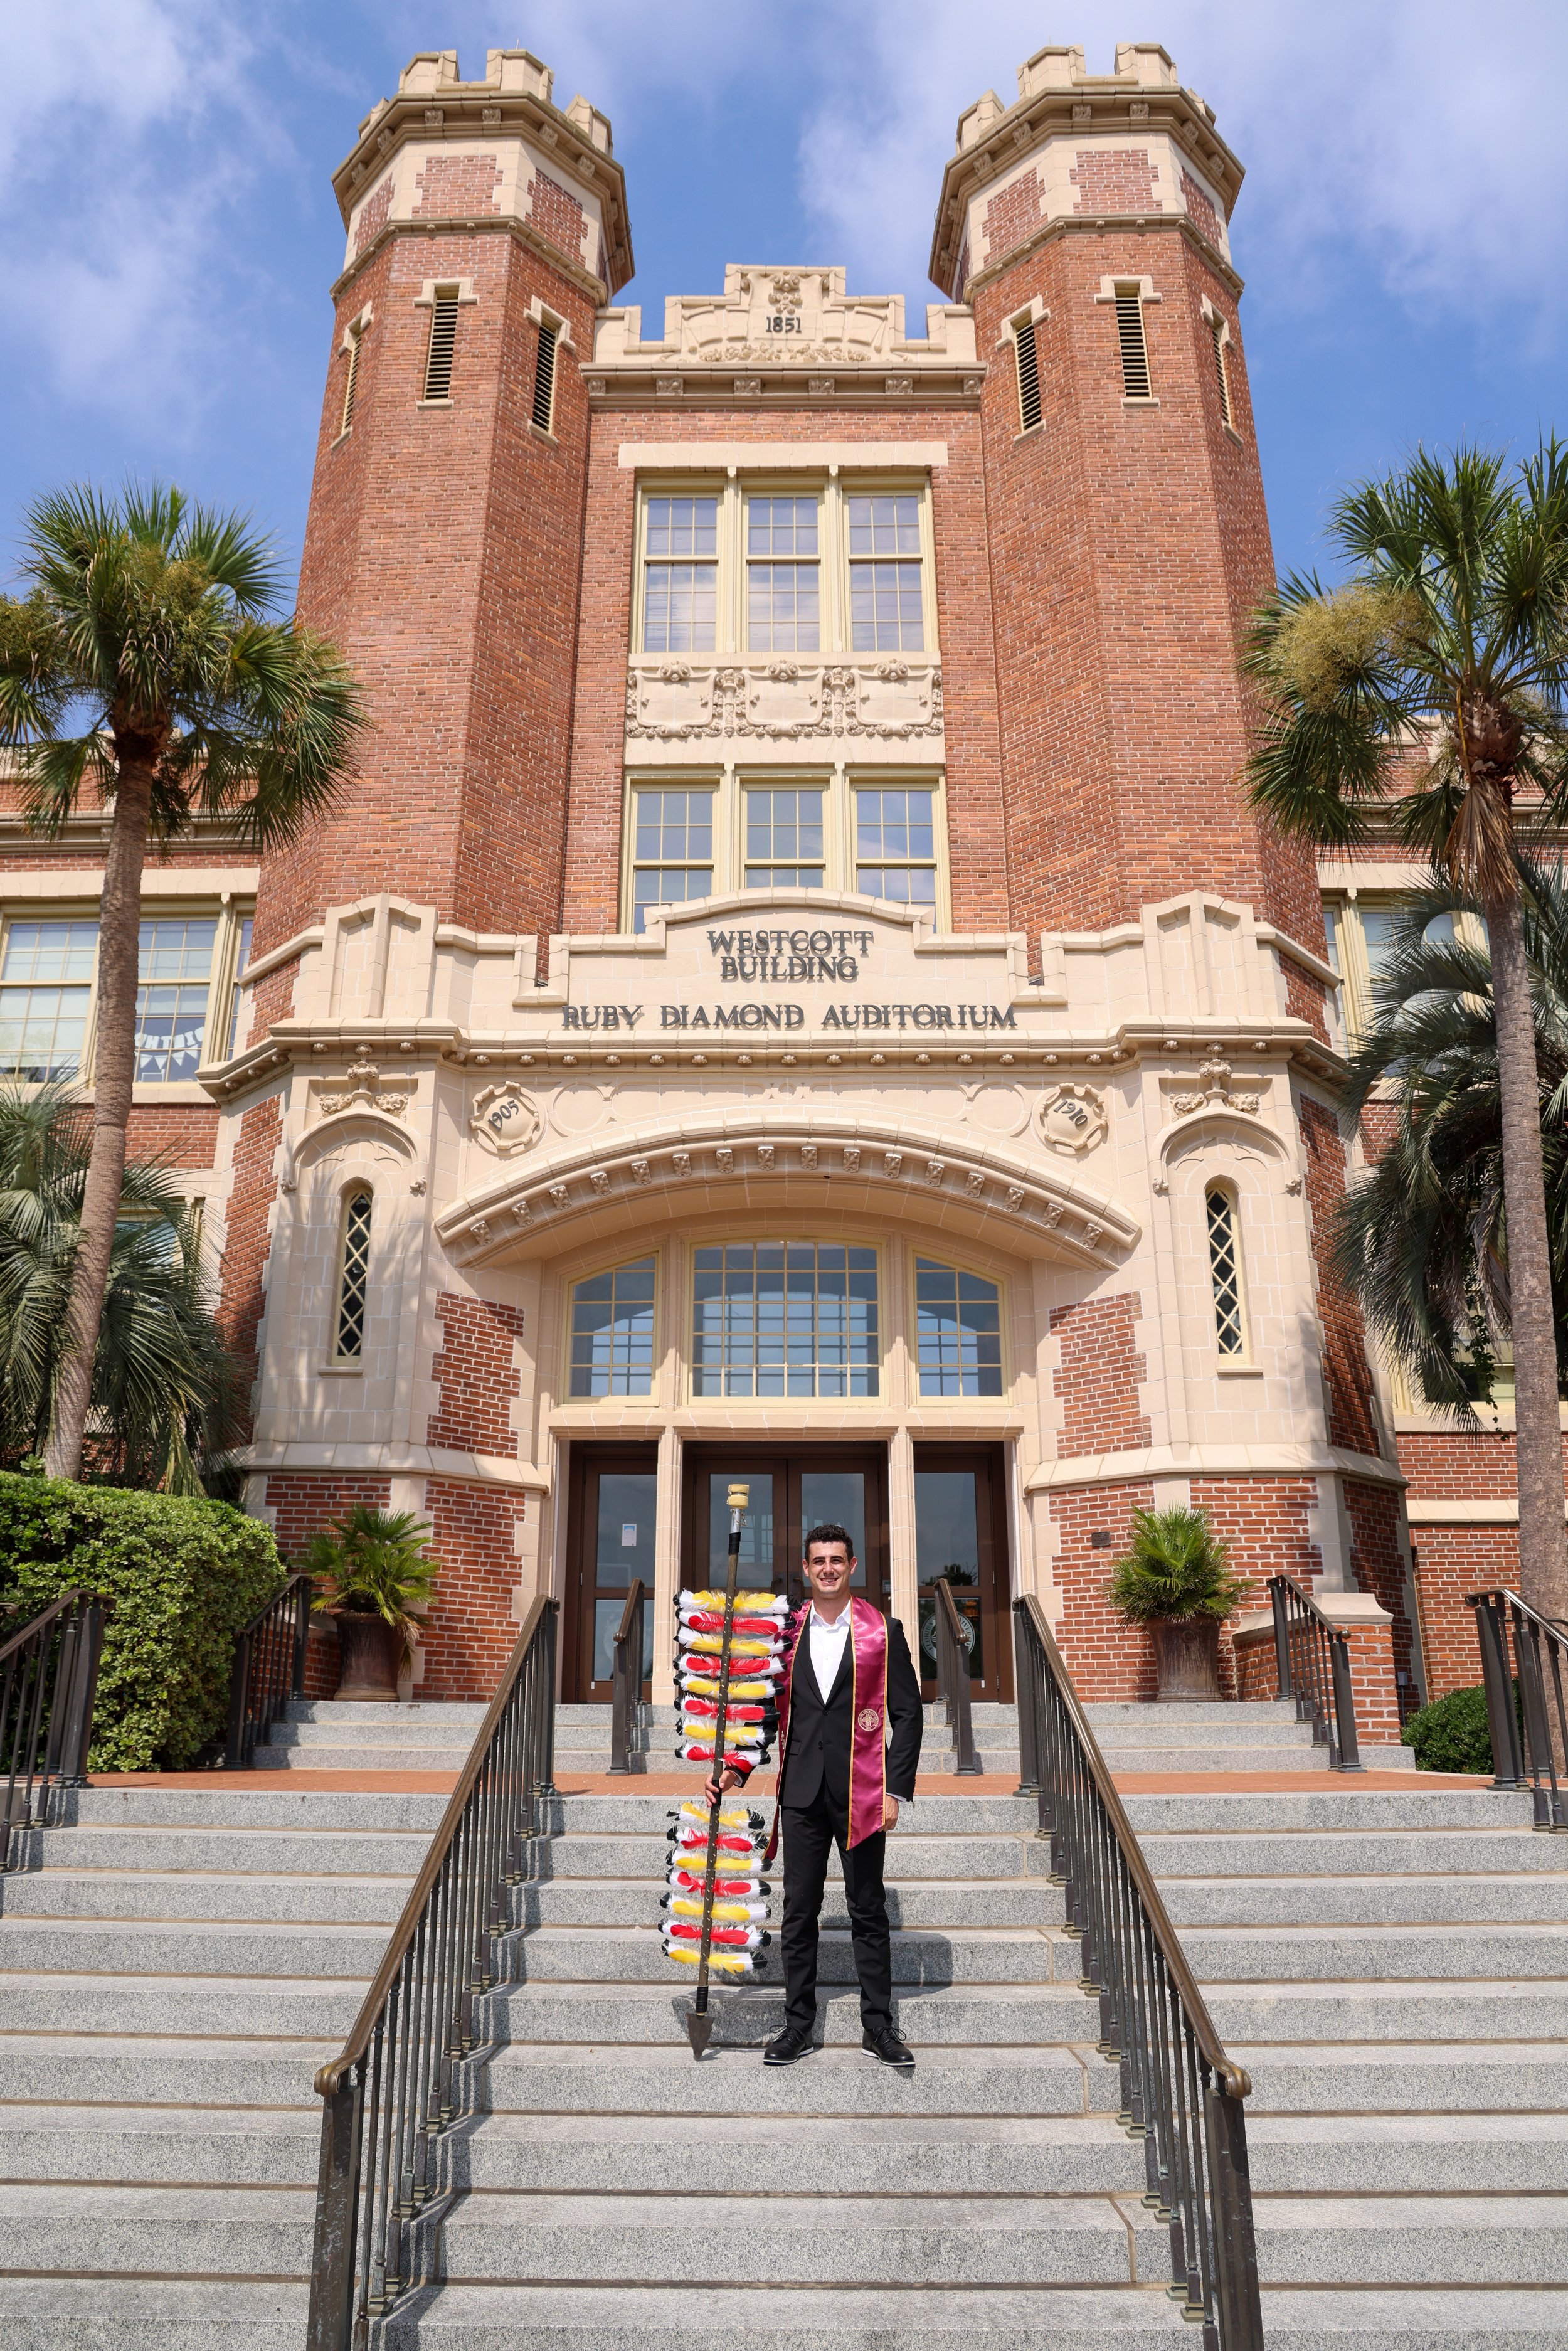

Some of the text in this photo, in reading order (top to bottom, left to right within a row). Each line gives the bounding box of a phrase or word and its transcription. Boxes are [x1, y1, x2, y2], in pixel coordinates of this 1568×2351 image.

[765, 316, 802, 334] 1851
[706, 930, 875, 955] WESTCOTT
[720, 955, 860, 980] BUILDING
[562, 1004, 1018, 1027] RUBY DIAMOND AUDITORIUM
[487, 1099, 519, 1132] 1905
[1053, 1099, 1088, 1127] 1910
[924, 1622, 934, 1651] FLORIDA
